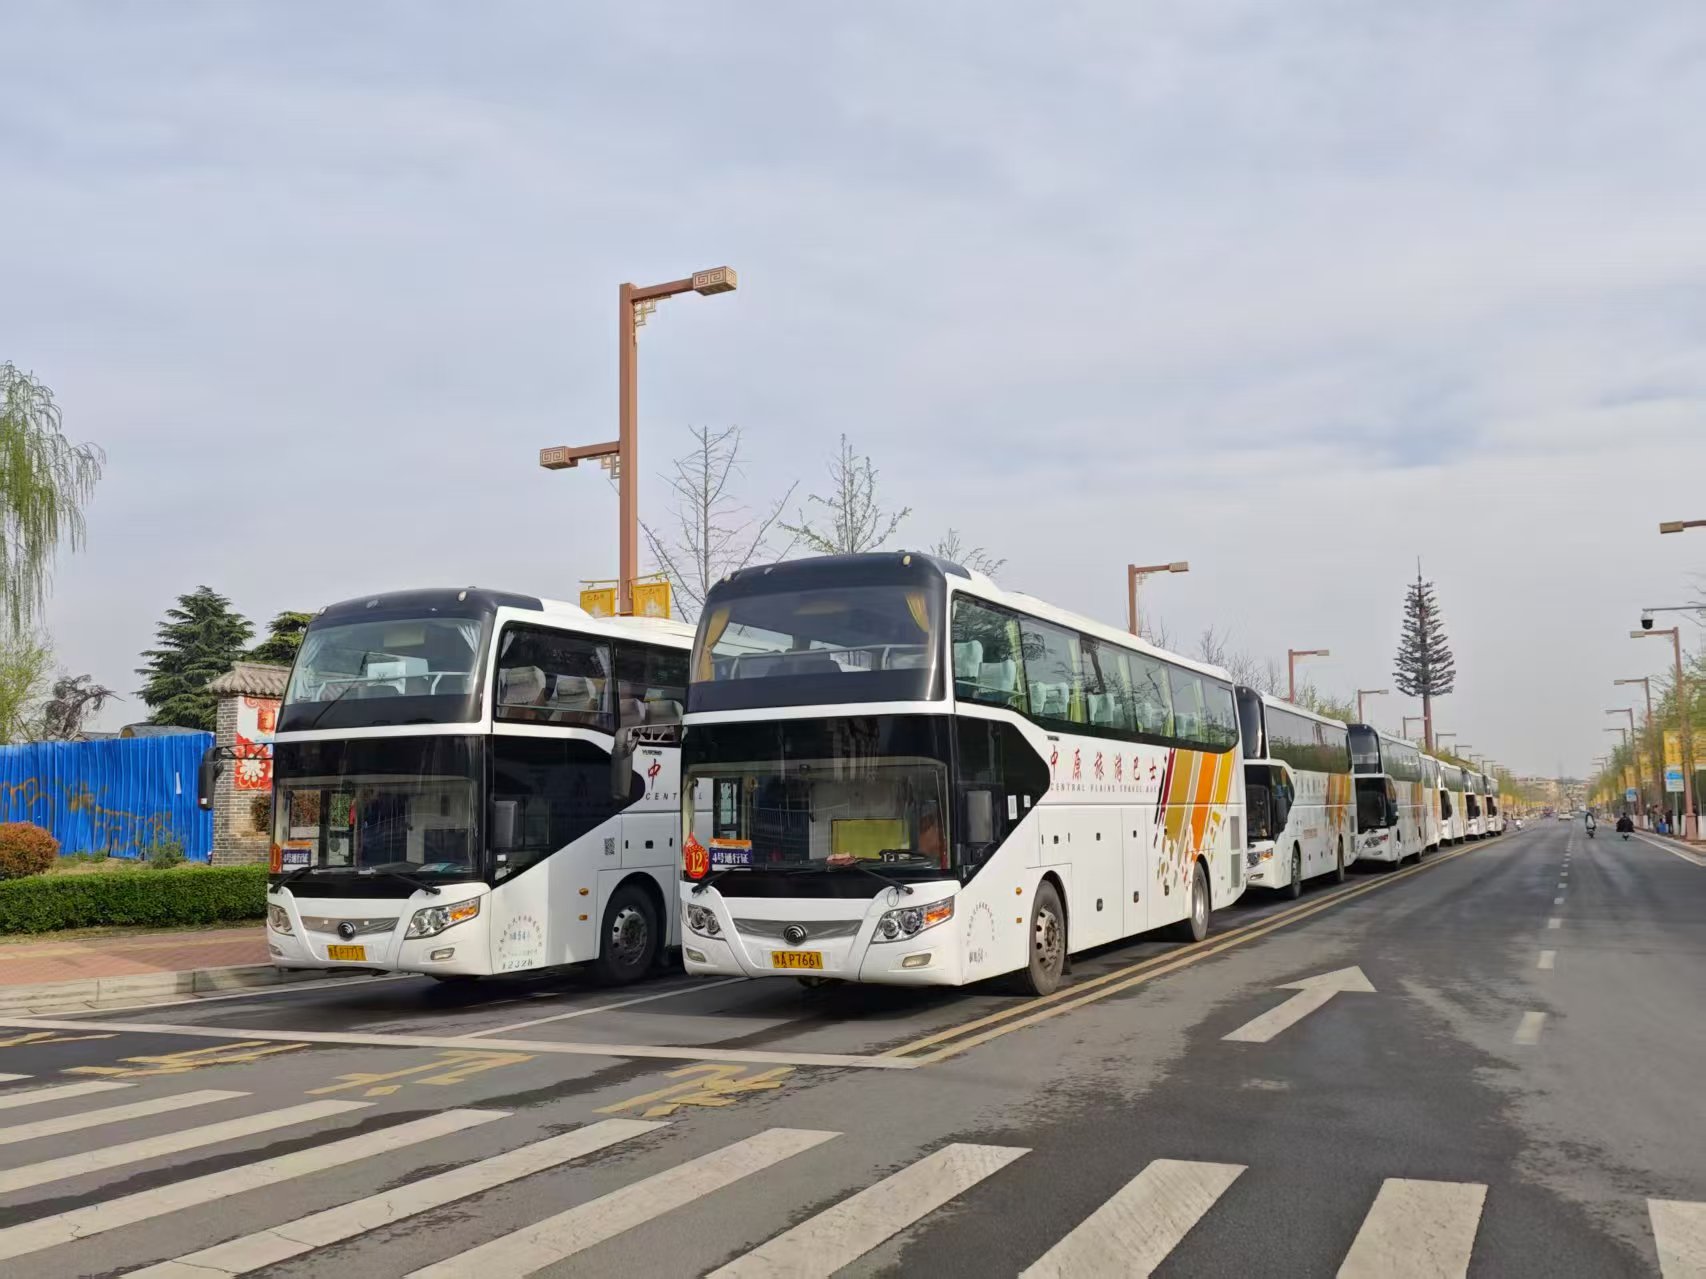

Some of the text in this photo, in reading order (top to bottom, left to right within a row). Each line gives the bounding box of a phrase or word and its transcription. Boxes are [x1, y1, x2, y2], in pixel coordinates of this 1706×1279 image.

[647, 758, 661, 790] 中
[1050, 783, 1085, 792] CENTRAL
[1090, 784, 1116, 793] PLAINS
[690, 851, 704, 872] 12
[712, 851, 750, 864] 4号通行证
